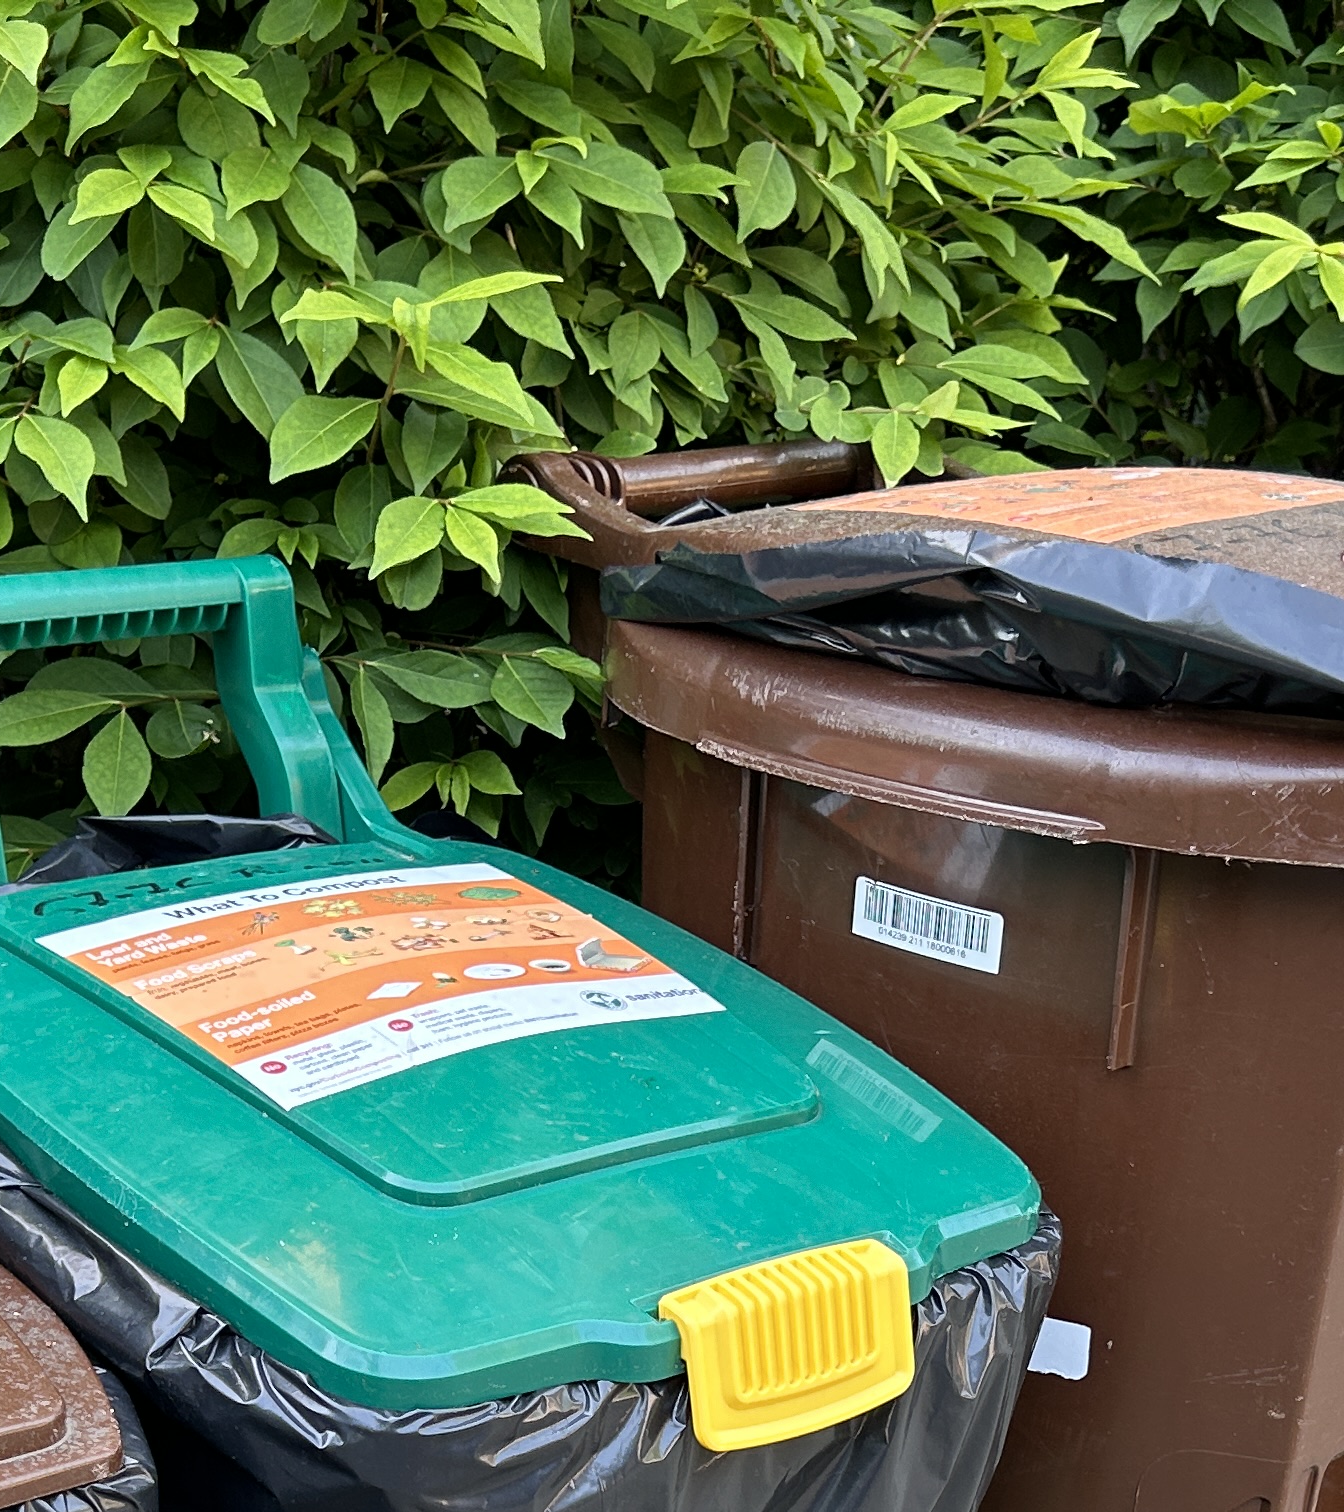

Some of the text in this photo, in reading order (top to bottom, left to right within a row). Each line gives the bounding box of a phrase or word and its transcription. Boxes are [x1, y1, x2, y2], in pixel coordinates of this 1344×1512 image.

[164, 873, 406, 919] What To Compost
[86, 932, 172, 961] Leaf and
[96, 934, 207, 967] Yard Waste
[133, 950, 257, 991] Food Scraps
[198, 990, 316, 1034] Food-soiled
[211, 1018, 272, 1043] Paper
